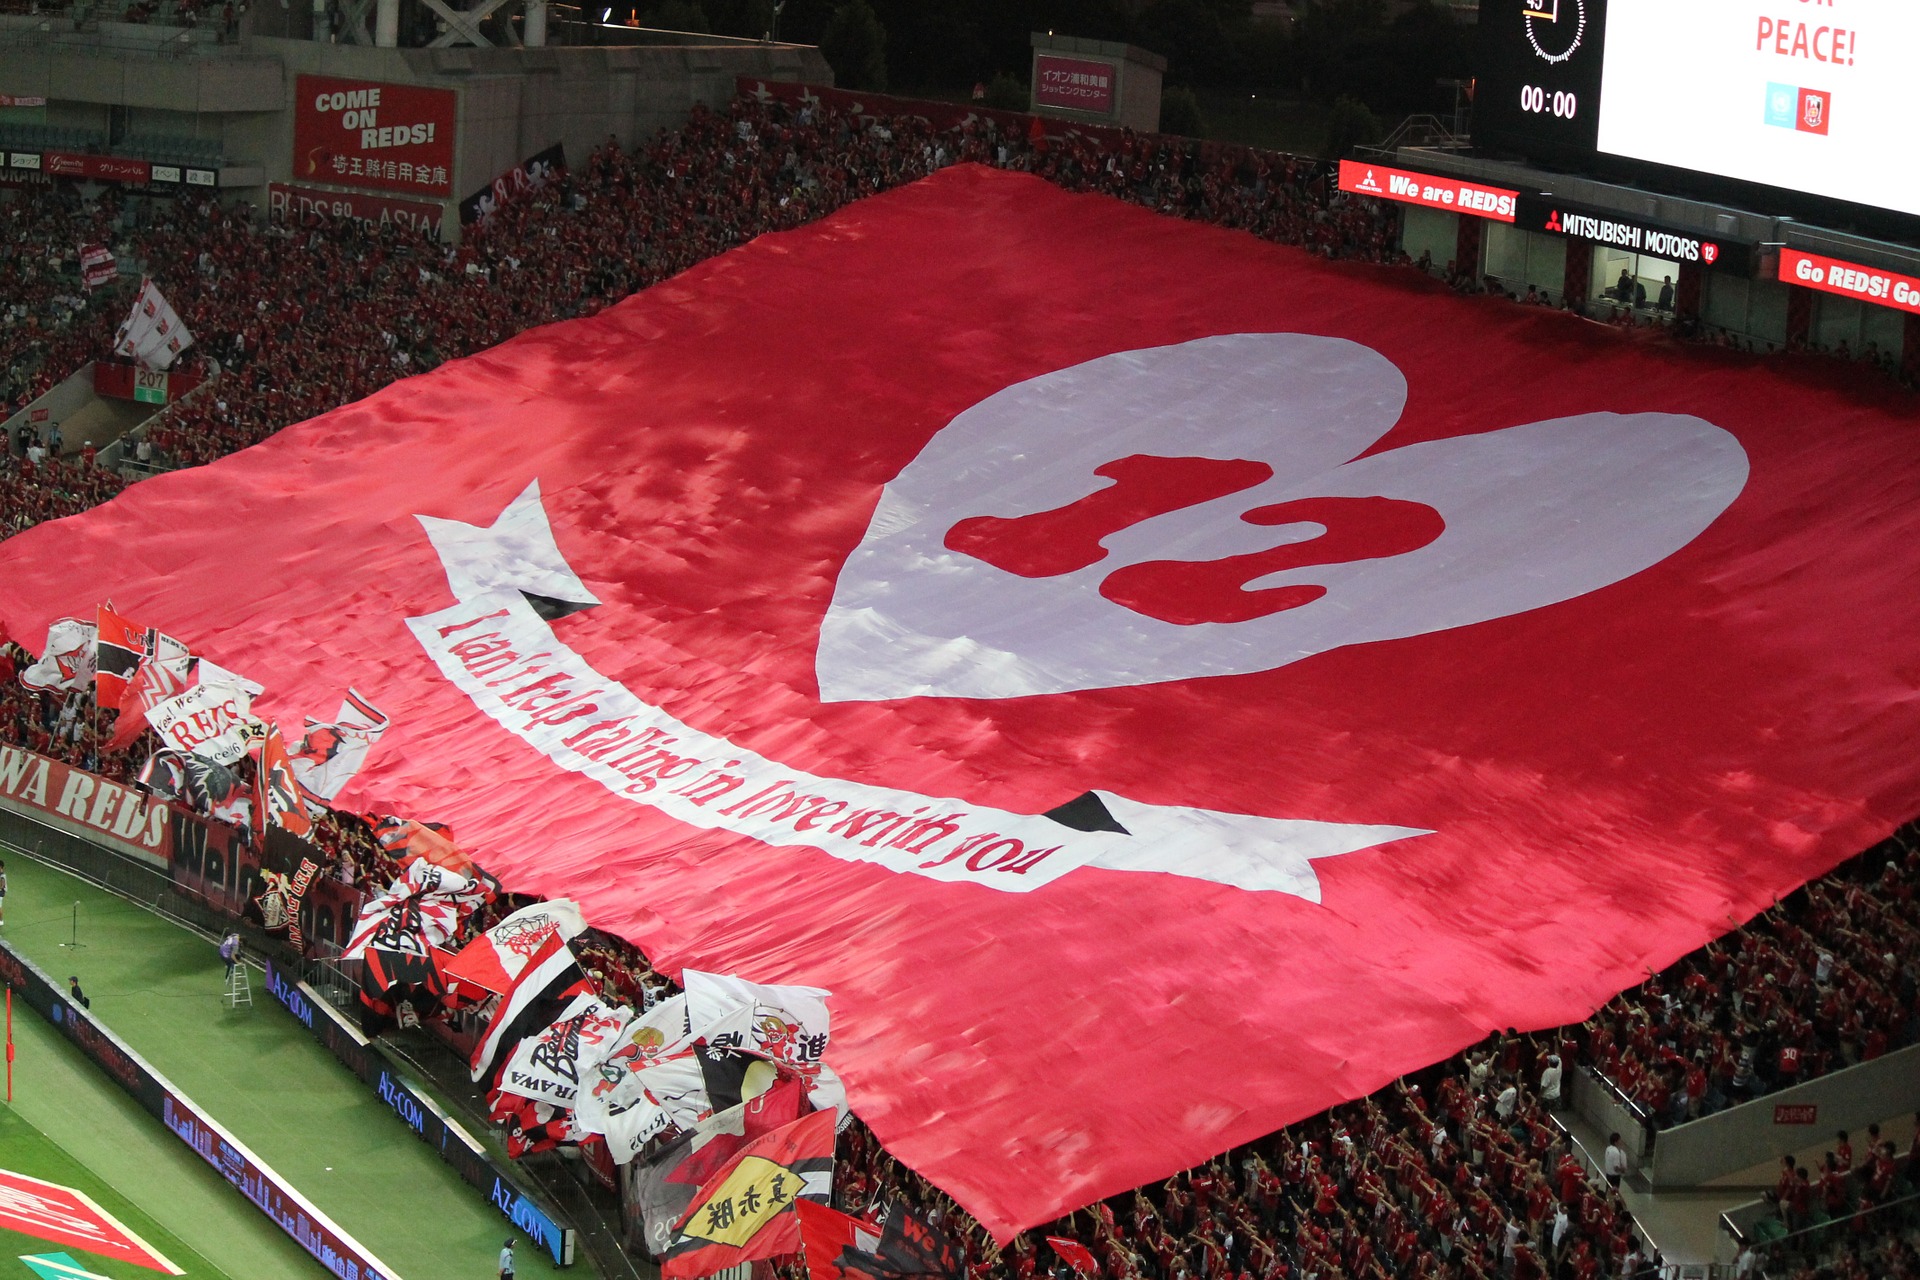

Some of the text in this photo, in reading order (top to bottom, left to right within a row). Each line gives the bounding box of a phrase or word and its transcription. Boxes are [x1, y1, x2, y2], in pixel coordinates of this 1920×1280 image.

[1756, 16, 1855, 66] PEACE!
[1041, 84, 1107, 98] ショッピングセンター
[1043, 70, 1108, 88] イオン浦和美園
[315, 88, 381, 112] COME
[1521, 85, 1576, 119] 00:00
[342, 109, 377, 130] ON
[361, 122, 435, 149] REDS!
[332, 201, 353, 218] GO
[1389, 175, 1419, 197] We
[1422, 186, 1454, 204] are
[1458, 188, 1517, 217] REDS!
[1563, 213, 1714, 261] MITSUBISHI MOTORS 12
[1796, 259, 1824, 282] Go
[1828, 265, 1891, 298] REDS!
[138, 371, 164, 387] 207
[156, 706, 177, 735] Yes!
[437, 609, 510, 639] I
[668, 759, 746, 807] in
[717, 780, 849, 832] love
[918, 833, 1066, 875] you
[55, 770, 168, 848] REDS
[273, 971, 312, 1029] AZ-COM
[378, 1071, 423, 1134] AZ-COM
[492, 1176, 543, 1246] AZ-COM
